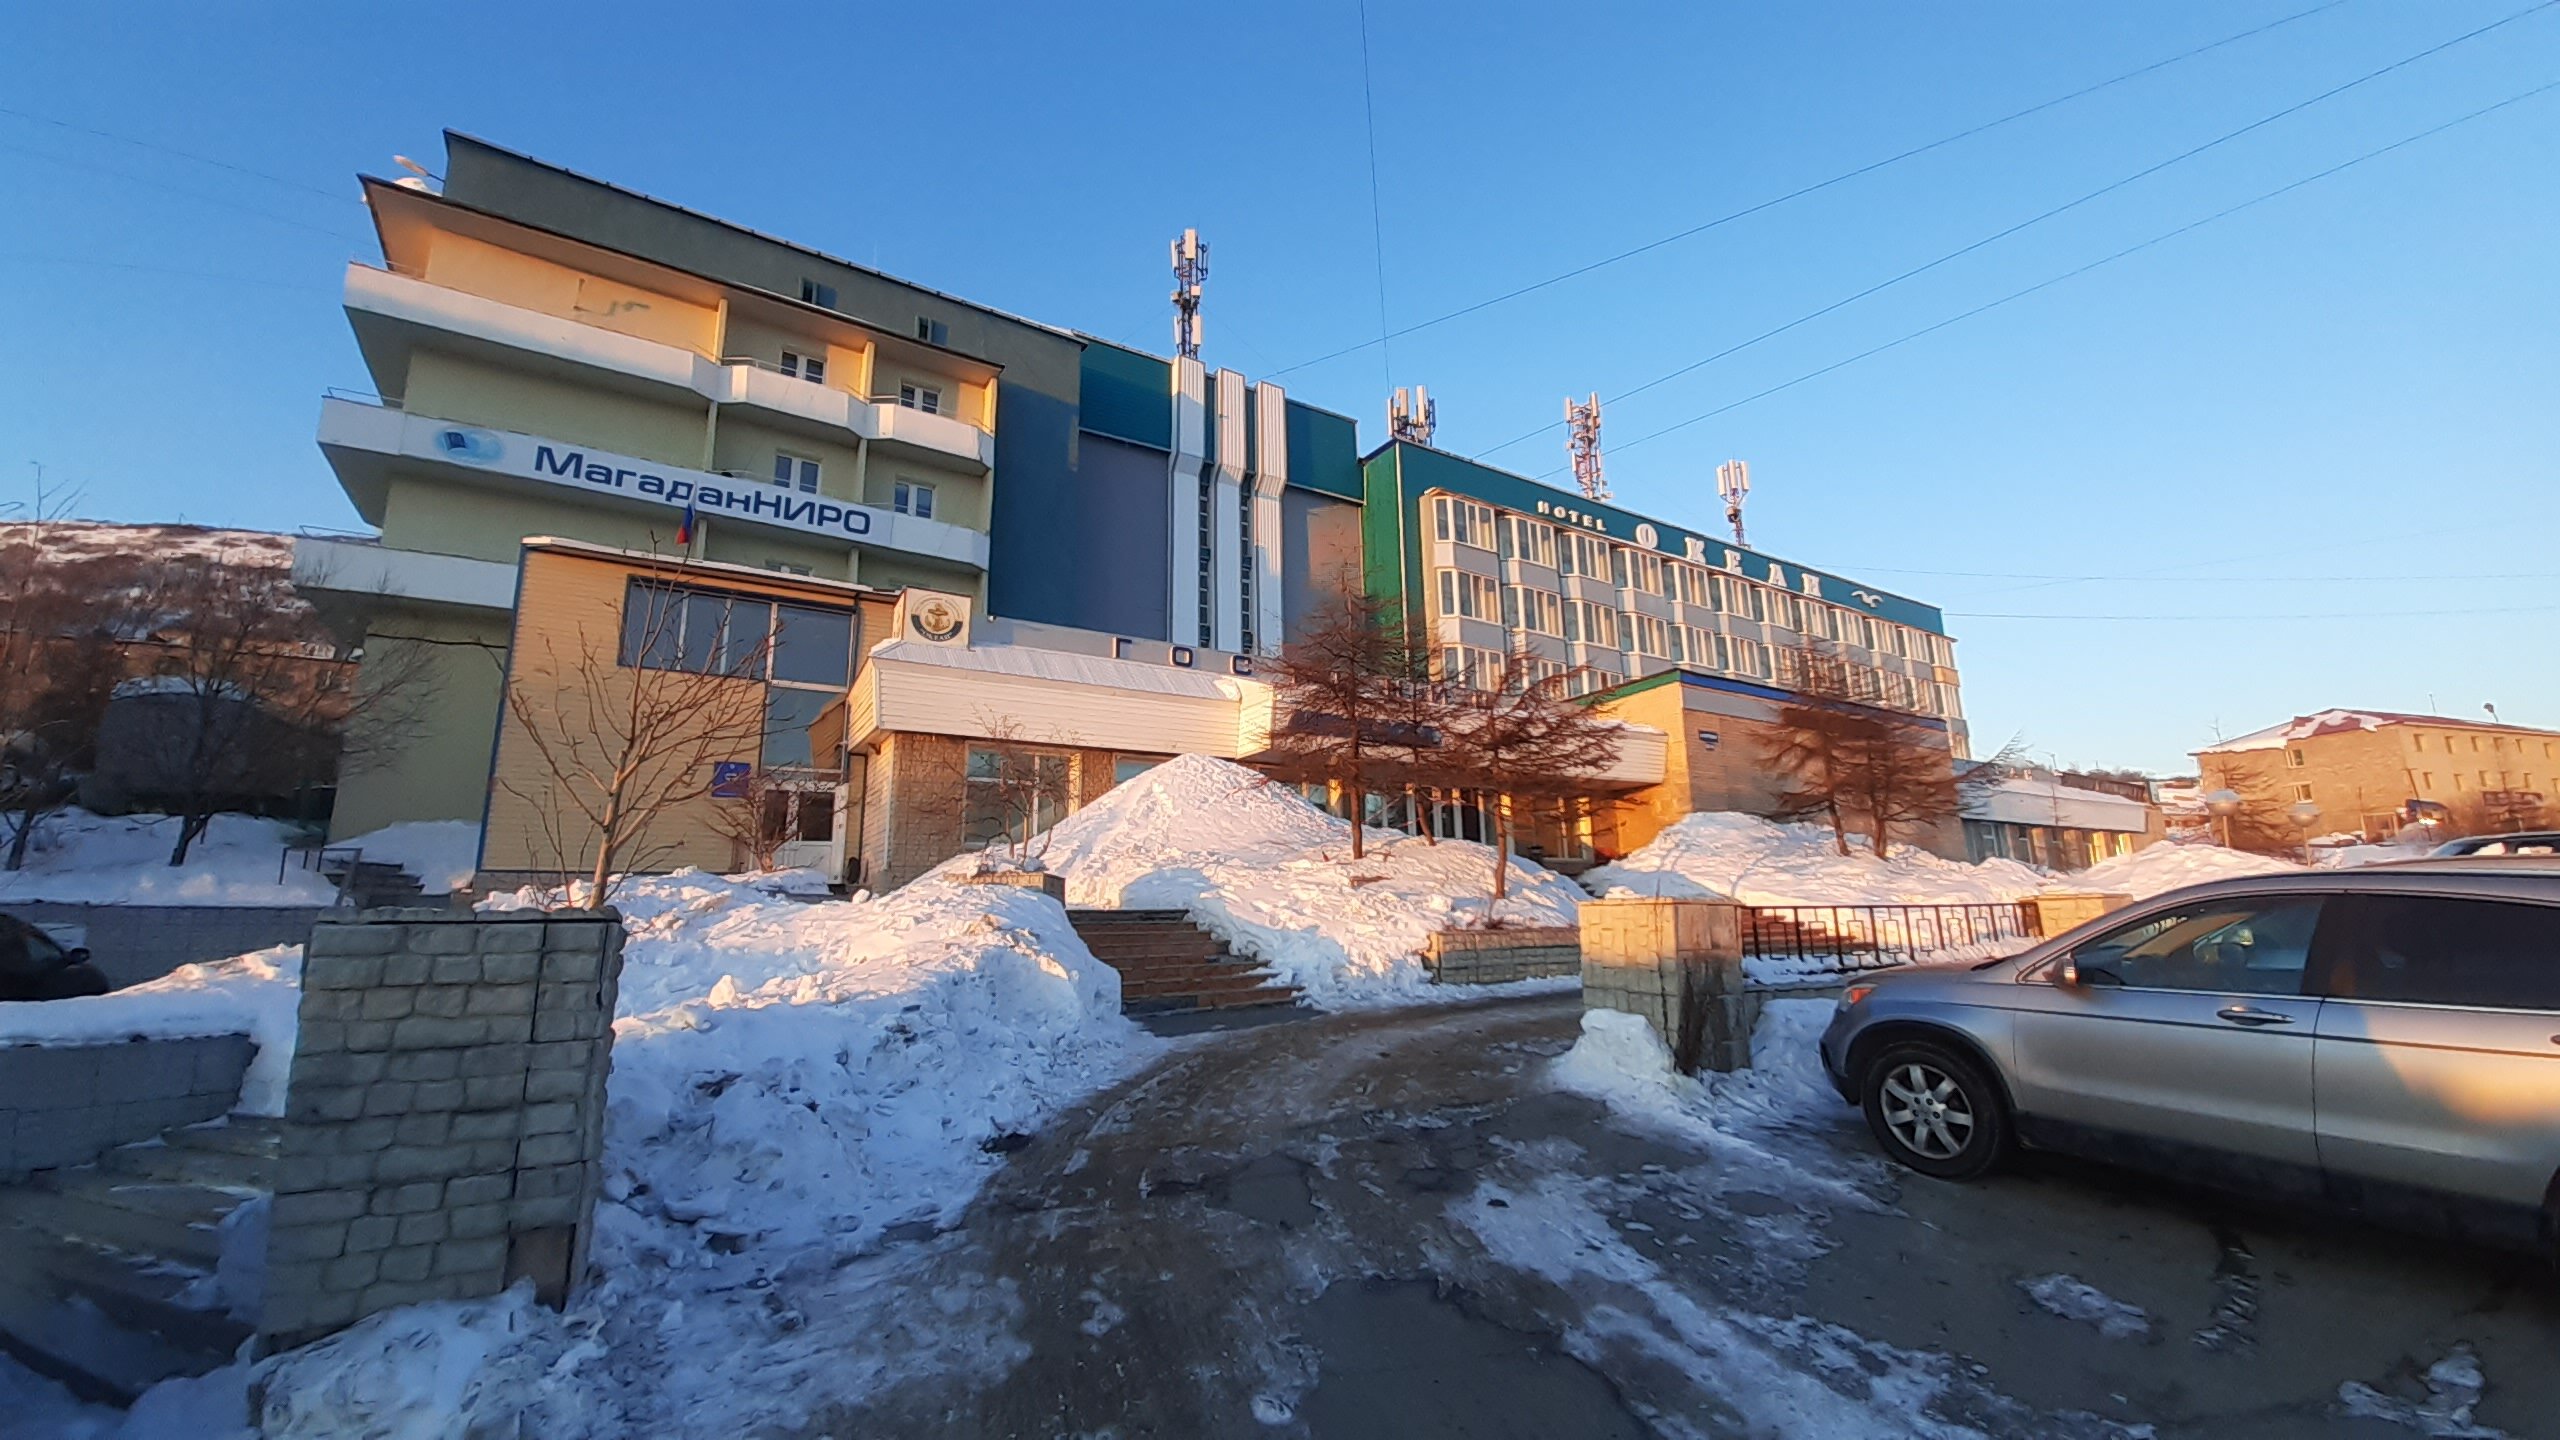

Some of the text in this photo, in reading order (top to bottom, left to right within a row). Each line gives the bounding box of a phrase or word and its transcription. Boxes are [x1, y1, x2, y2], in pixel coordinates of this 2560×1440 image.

[534, 445, 871, 535] МагаданНИРО
[1537, 500, 1608, 532] HOTEL
[1635, 522, 1822, 598] ОКЕАН
